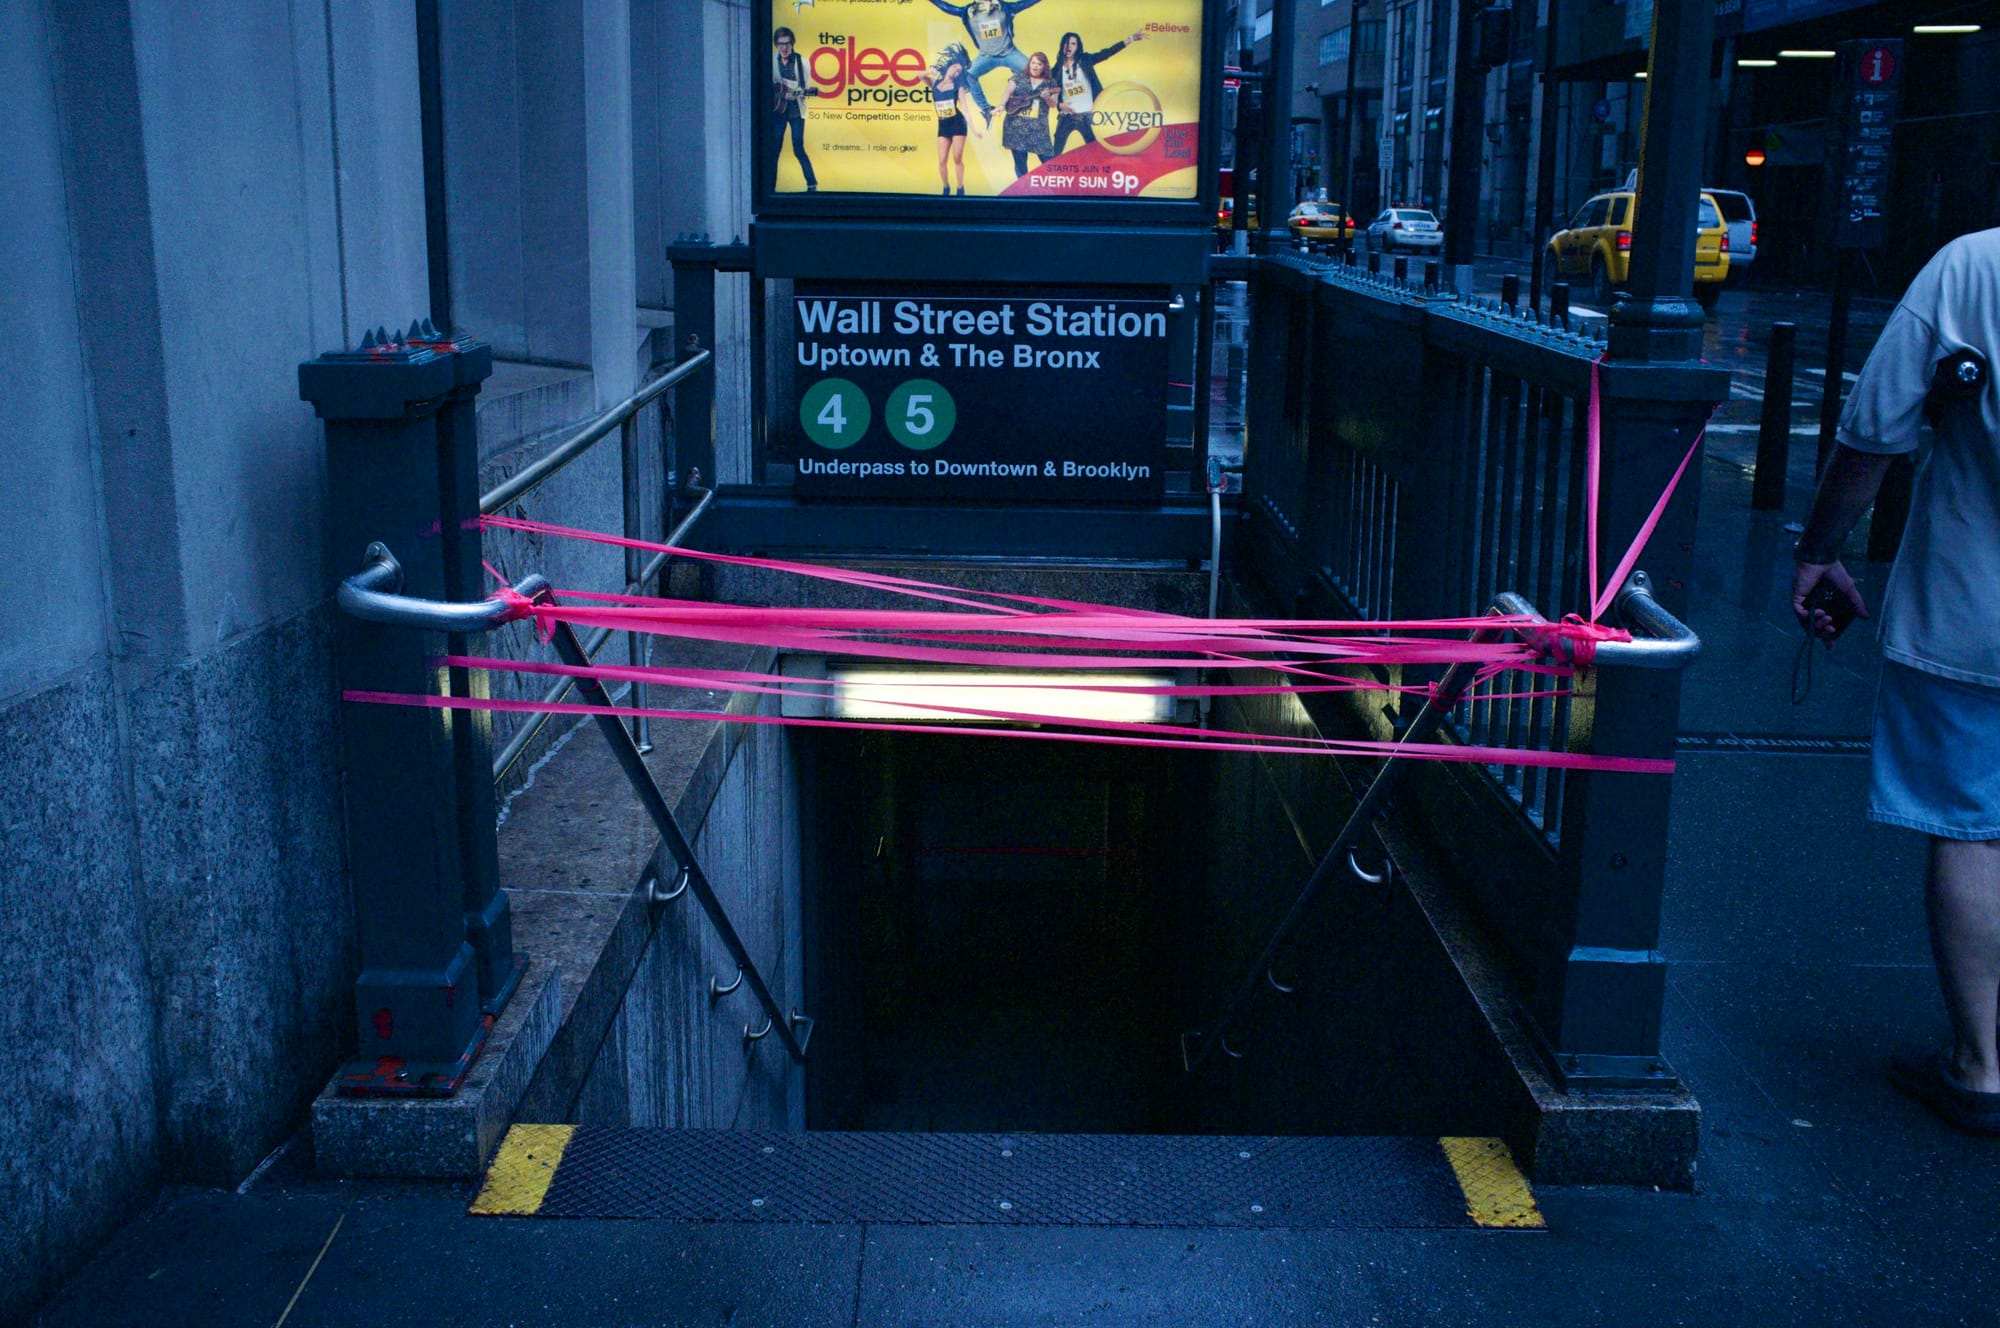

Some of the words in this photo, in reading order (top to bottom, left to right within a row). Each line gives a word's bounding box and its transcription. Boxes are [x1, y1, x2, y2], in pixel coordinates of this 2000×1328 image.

[984, 28, 998, 39] 147
[1144, 22, 1190, 33] #Believe
[818, 32, 846, 45] the
[809, 36, 926, 99] glee
[848, 85, 933, 106] project
[808, 111, 821, 120] So
[823, 112, 842, 120] New
[845, 112, 901, 122] Competition
[903, 113, 931, 121] Series
[1092, 110, 1163, 132] oxygen
[822, 143, 831, 151] 12
[1046, 164, 1080, 172] STARTS
[1082, 165, 1099, 173] JUN
[1030, 175, 1075, 188] EVERY
[1079, 176, 1108, 189] SUN
[1111, 171, 1139, 194] 9p
[799, 301, 880, 334] Wall
[893, 301, 1014, 335] Street
[1026, 303, 1166, 337] Station
[798, 342, 910, 370] Uptown
[920, 344, 940, 367] &
[949, 344, 1003, 367] The
[1014, 345, 1100, 368] Bronx
[817, 393, 847, 433] 4
[905, 394, 935, 435] 5
[800, 458, 904, 479] Underpass
[910, 460, 929, 476] to
[936, 460, 1037, 477] Downtown
[1044, 461, 1056, 477] &
[1063, 462, 1149, 480] Brooklyn
